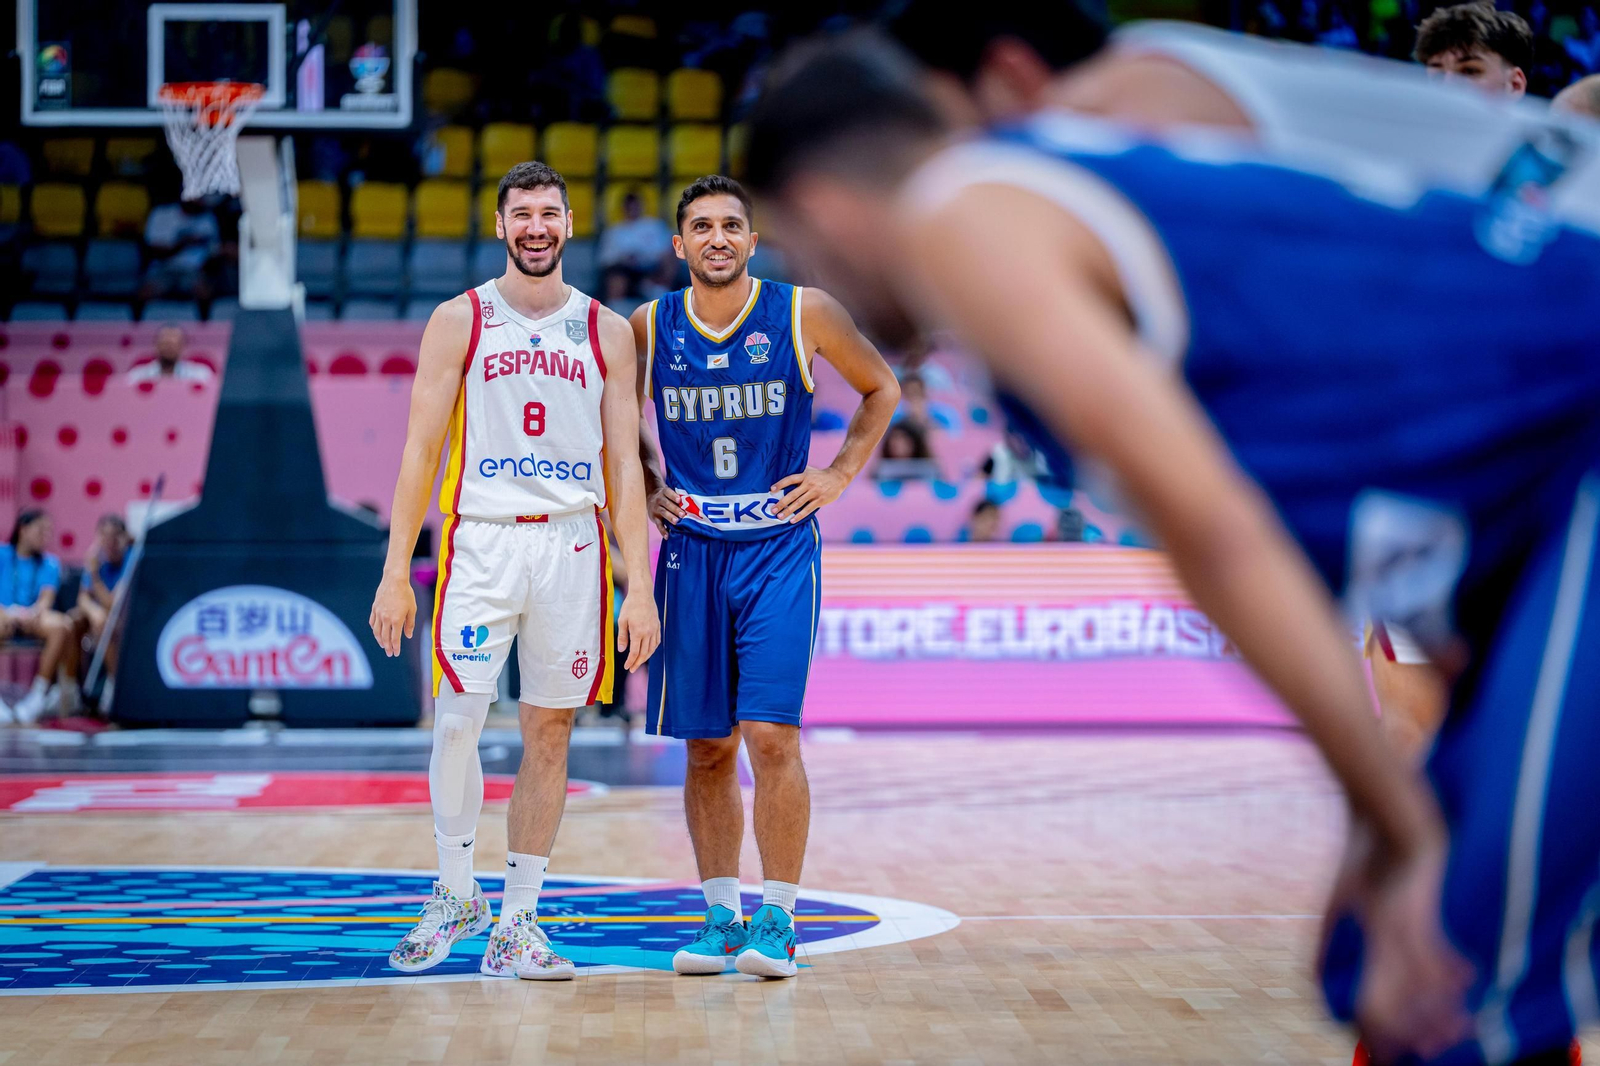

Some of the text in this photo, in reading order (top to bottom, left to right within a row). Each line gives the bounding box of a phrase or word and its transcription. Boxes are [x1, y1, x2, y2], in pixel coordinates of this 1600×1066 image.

[483, 349, 587, 390] ESPAÑA
[523, 401, 546, 437] 8
[662, 379, 787, 422] CYPRUS
[479, 453, 592, 481] endesa
[711, 436, 739, 480] 6
